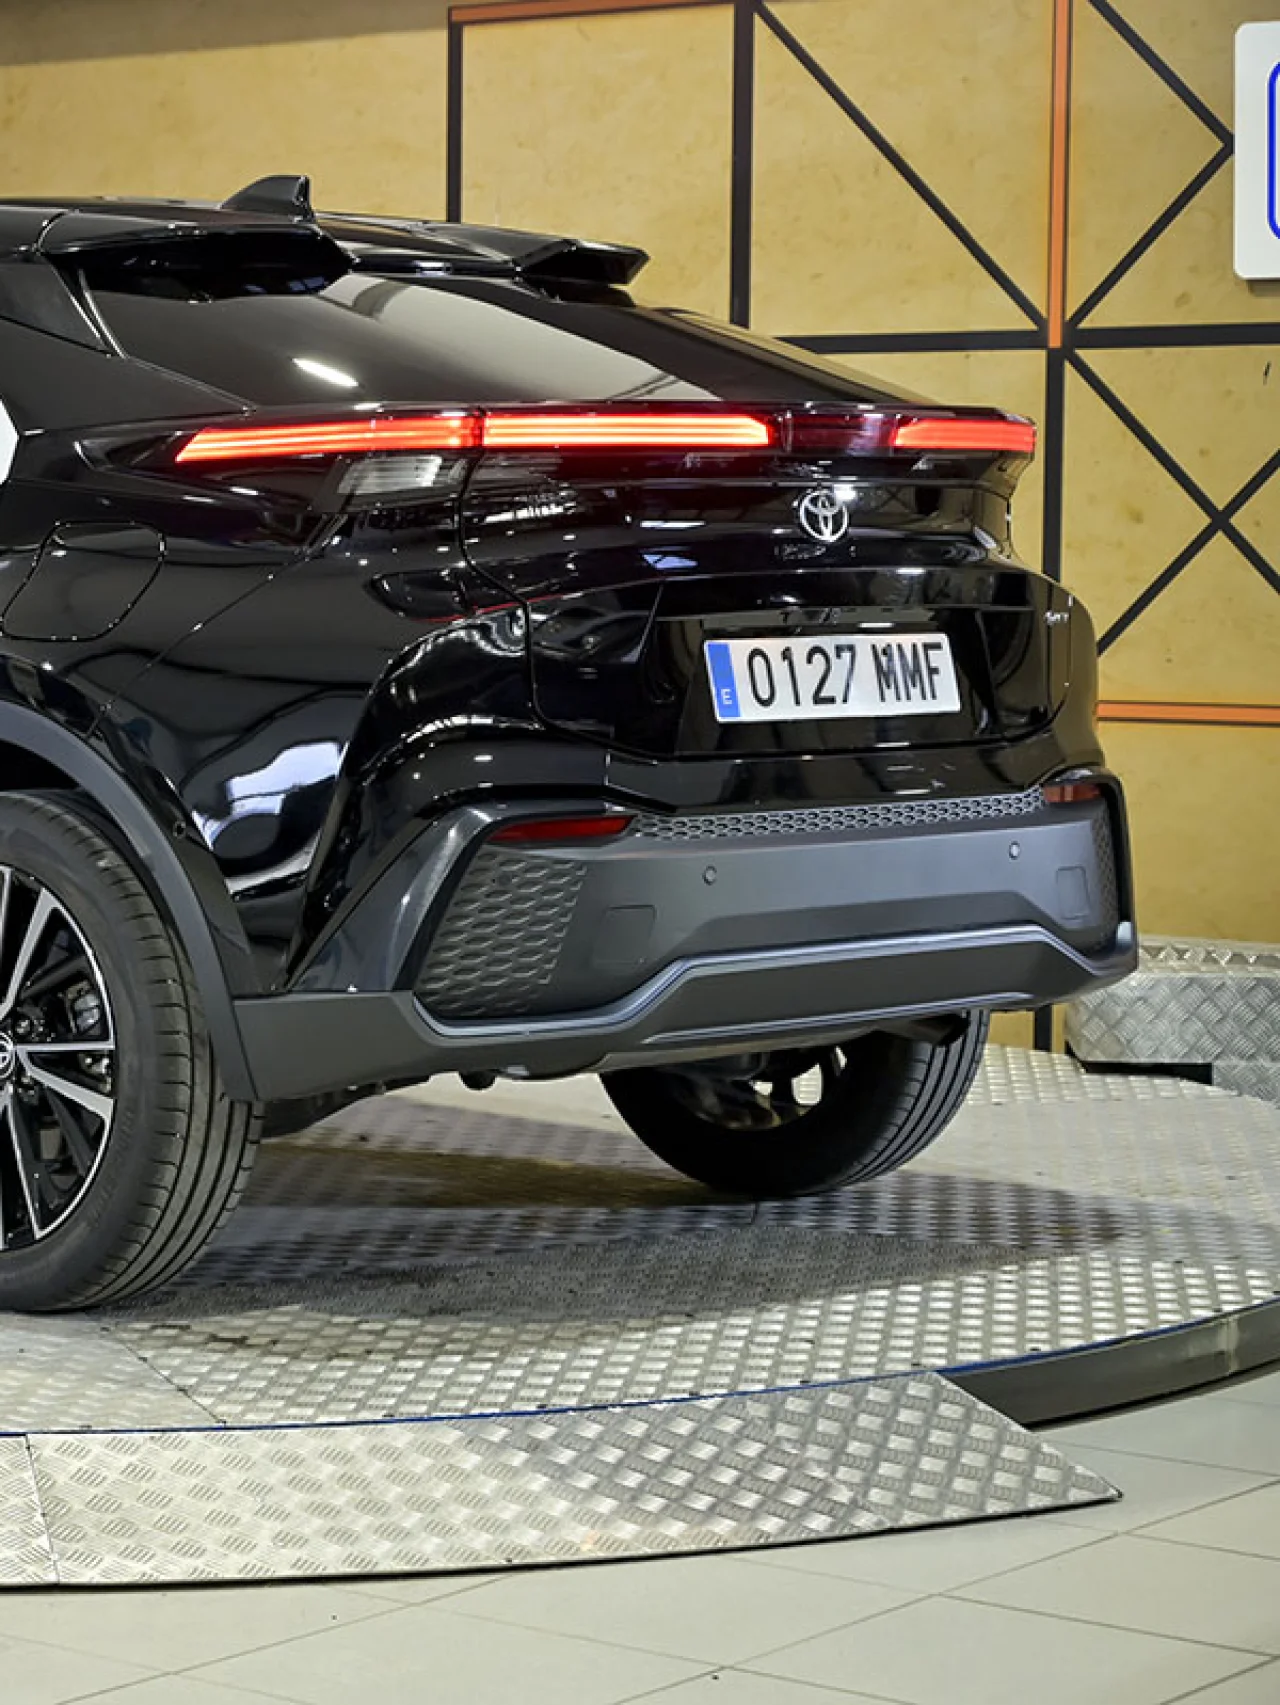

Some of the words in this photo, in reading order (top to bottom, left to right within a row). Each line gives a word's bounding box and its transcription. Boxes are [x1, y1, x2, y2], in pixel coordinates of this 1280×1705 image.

[747, 644, 856, 708] 0127
[870, 642, 943, 702] MMF
[720, 688, 733, 705] E
